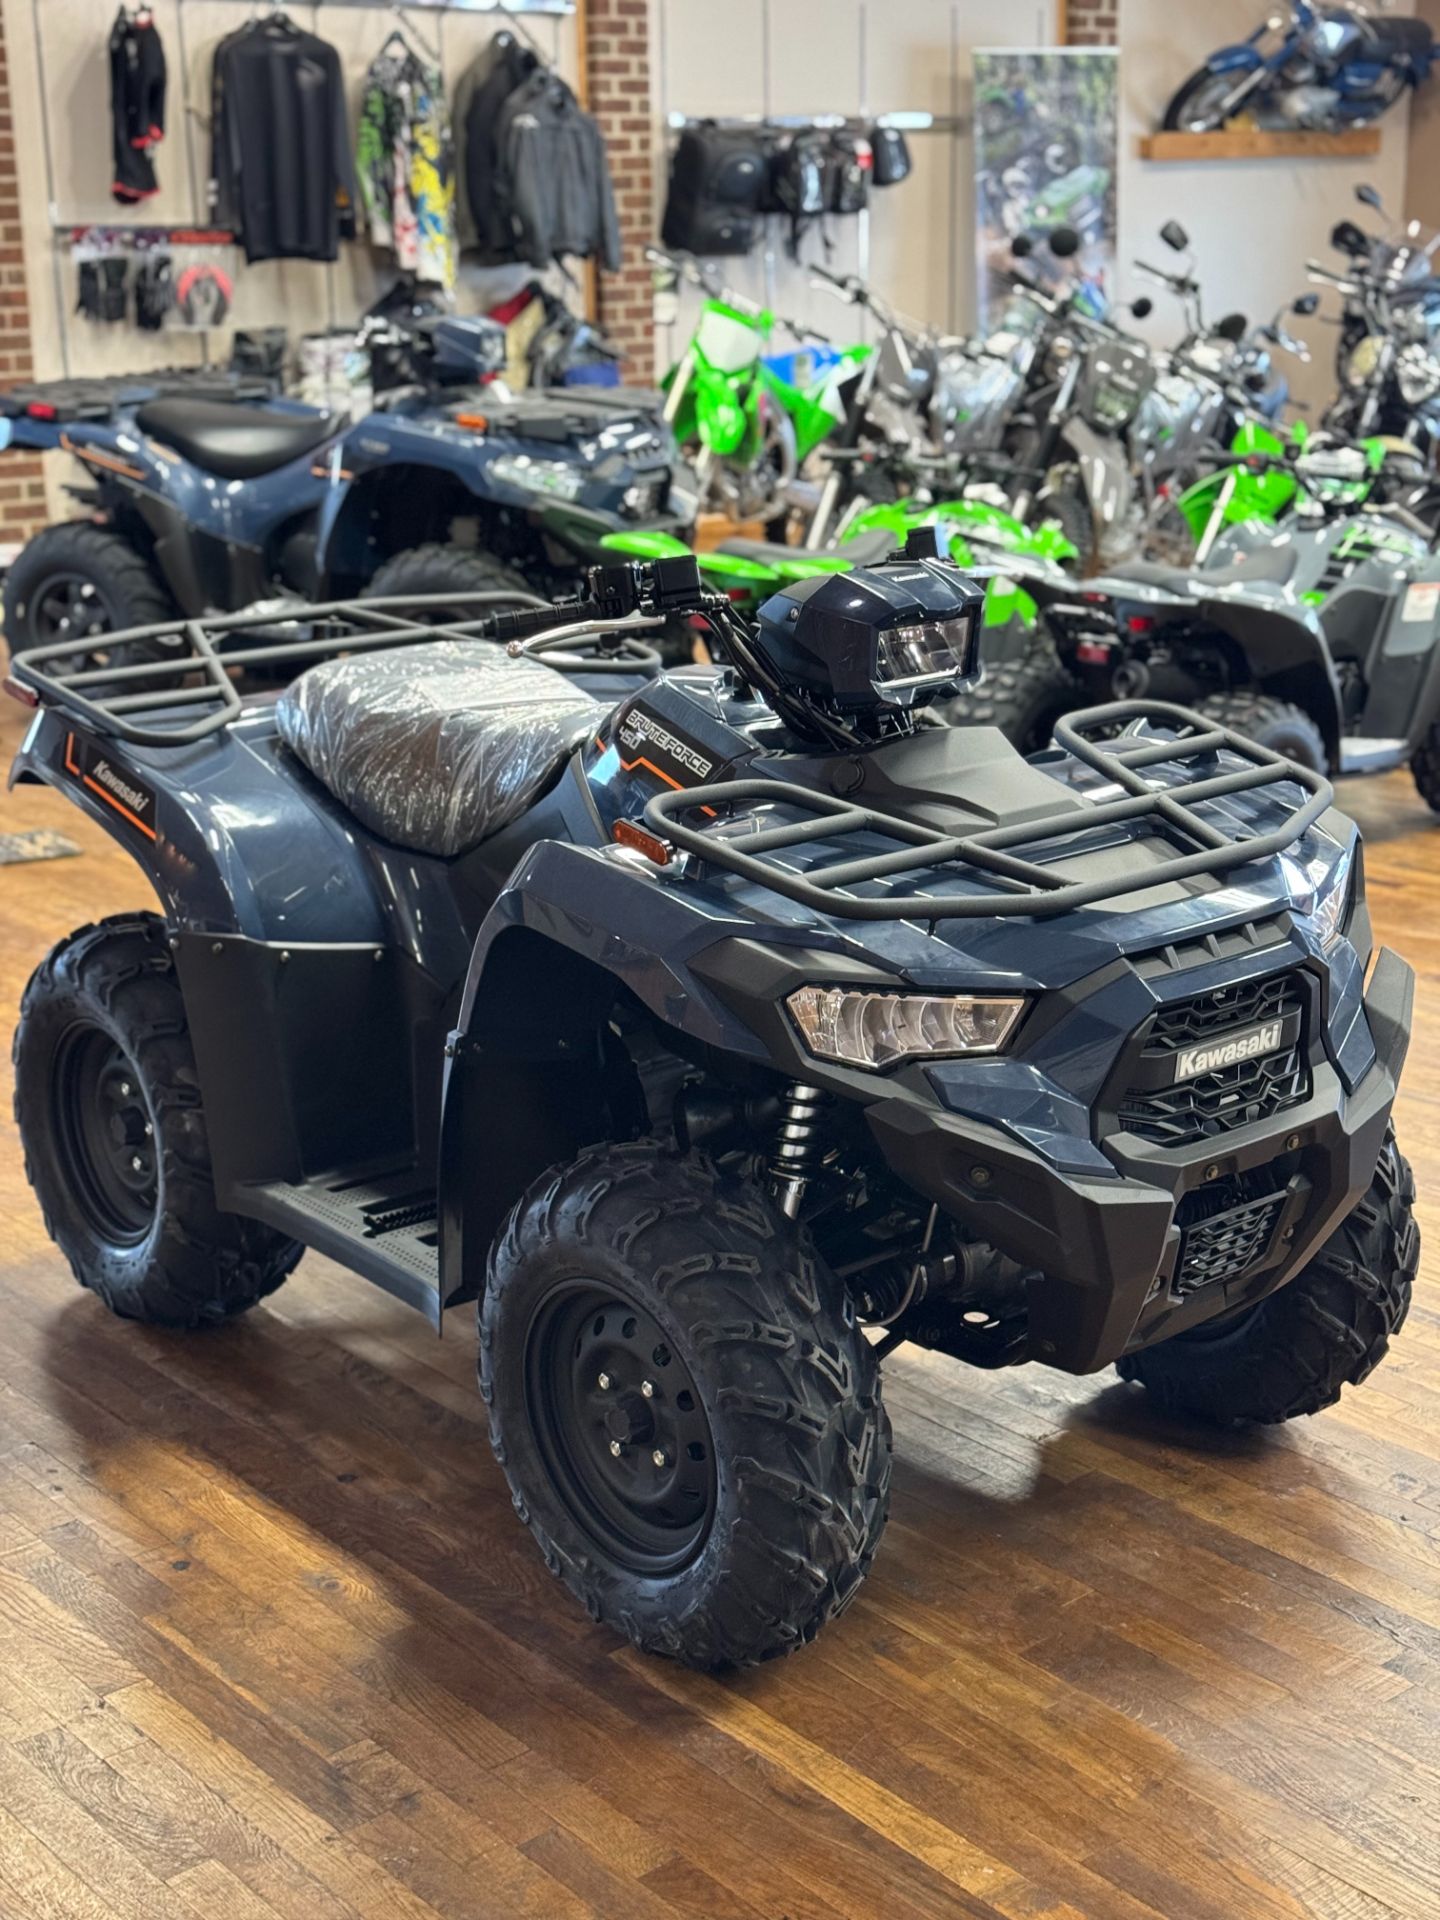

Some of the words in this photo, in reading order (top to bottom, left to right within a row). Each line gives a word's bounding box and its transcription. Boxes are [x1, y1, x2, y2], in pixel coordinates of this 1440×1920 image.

[619, 726, 642, 750] 450
[93, 760, 149, 812] Kawasaki
[1179, 1024, 1279, 1077] Kawasaki
